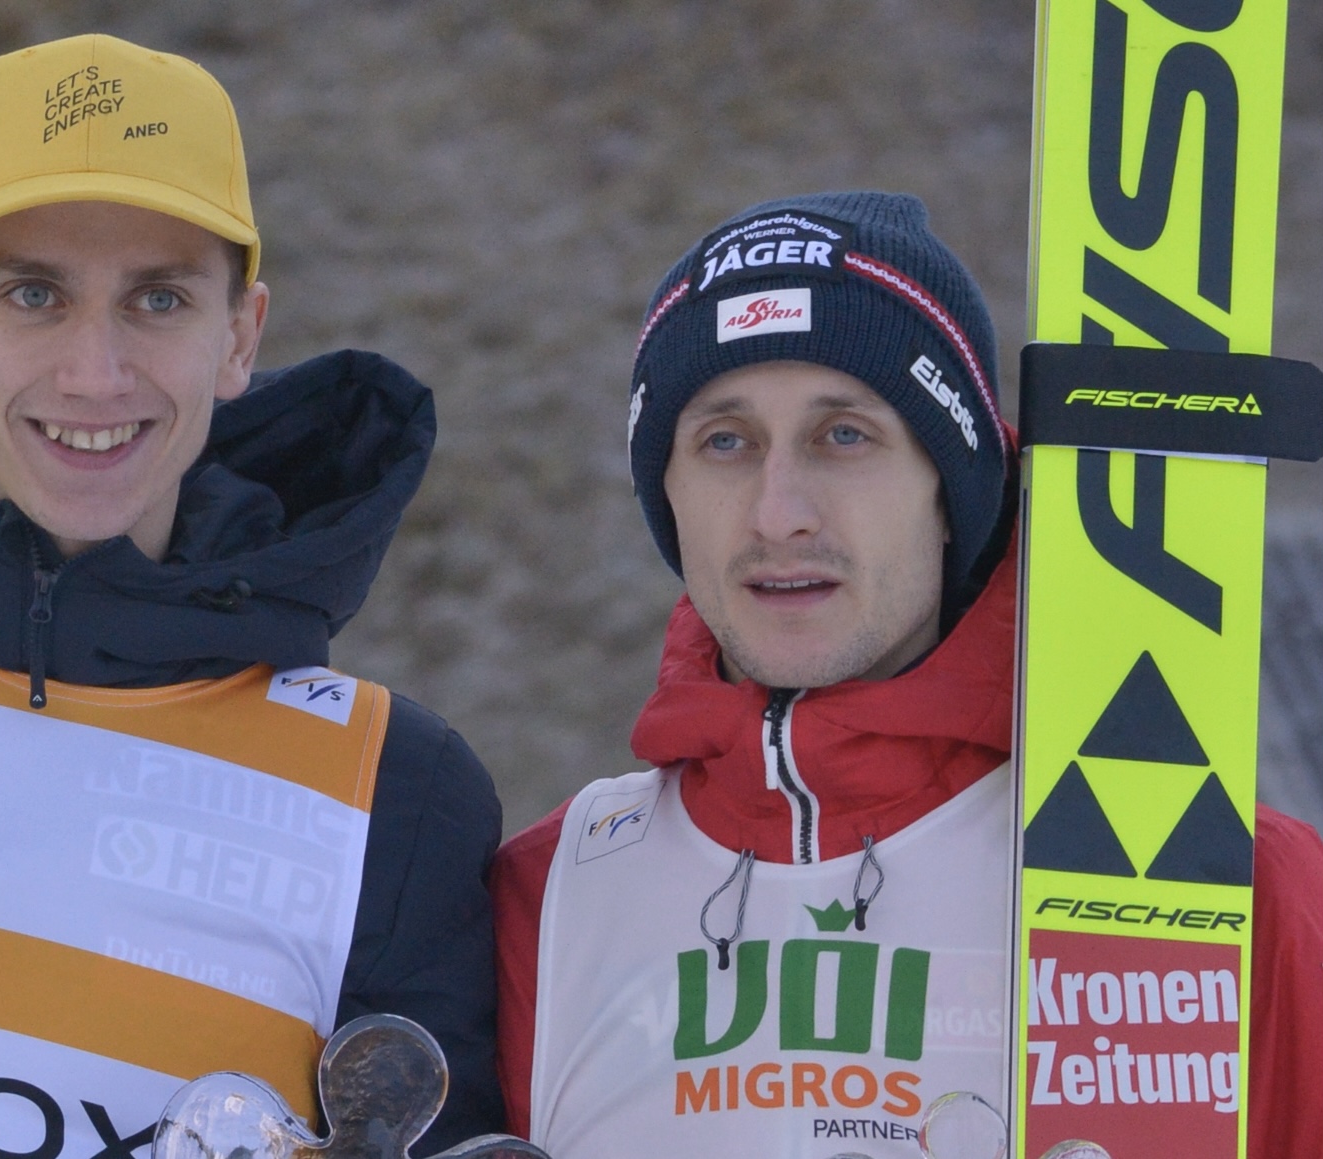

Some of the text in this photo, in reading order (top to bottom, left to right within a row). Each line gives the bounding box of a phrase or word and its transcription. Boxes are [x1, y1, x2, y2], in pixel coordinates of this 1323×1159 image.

[45, 66, 99, 104] LET'S
[45, 79, 122, 121] CREATE
[43, 96, 125, 144] ENERGY
[123, 122, 168, 140] ANEO
[743, 227, 796, 242] WERNER
[698, 240, 832, 292] JÄGER
[724, 305, 803, 329] AUSTRIA
[1065, 389, 1237, 413] FISCHER
[588, 813, 646, 836] FIS
[1035, 898, 1247, 932] FISCHER
[1028, 957, 1239, 1025] Kronen
[675, 1063, 922, 1116] MIGROS
[1027, 1036, 1240, 1113] Zeitung
[813, 1119, 919, 1141] PARTNER
